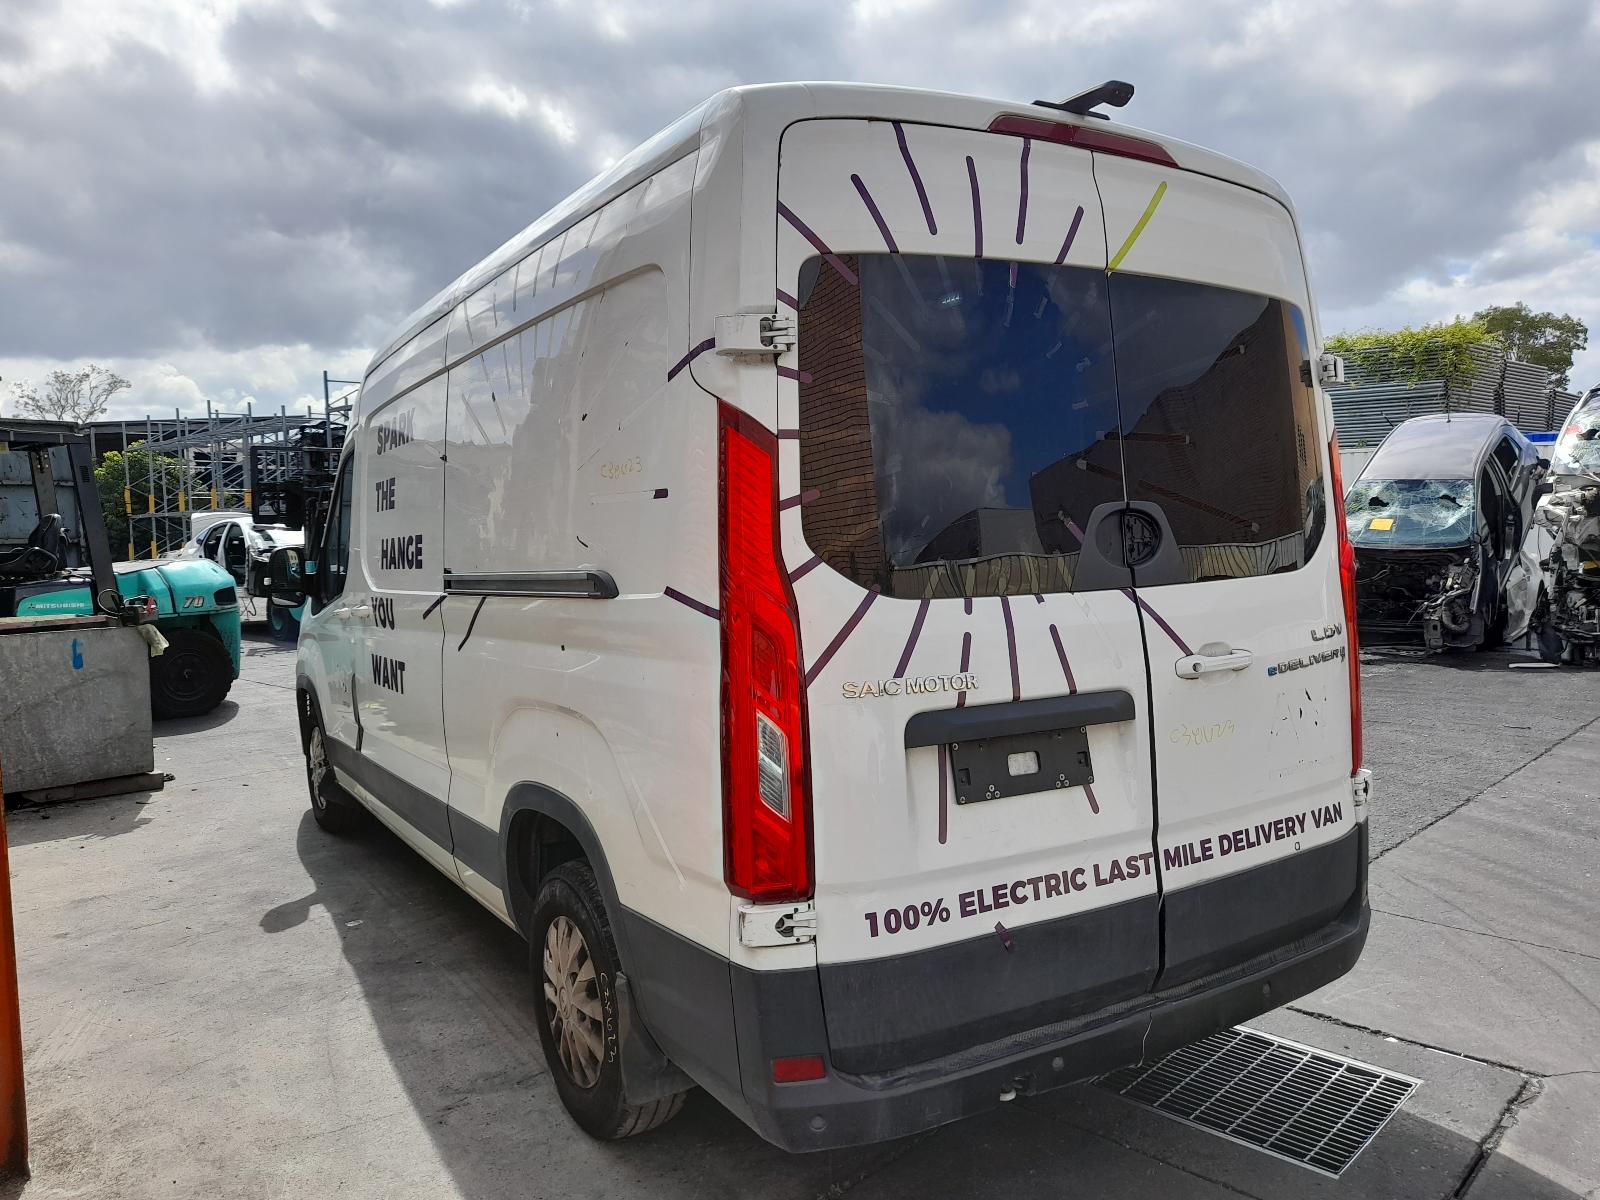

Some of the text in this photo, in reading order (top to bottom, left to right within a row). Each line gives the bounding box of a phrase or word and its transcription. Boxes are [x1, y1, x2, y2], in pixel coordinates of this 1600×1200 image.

[376, 407, 416, 456] SPARK
[375, 477, 396, 513] THE
[380, 534, 423, 570] HANGE
[182, 596, 205, 608] 70
[370, 596, 395, 631] YOU
[1310, 622, 1343, 642] LDV
[371, 653, 406, 695] WANT
[842, 672, 979, 699] SAIC MOTOR
[864, 801, 1344, 938] 100% ELECTRIC LAST MILE DELIVERY VAN
